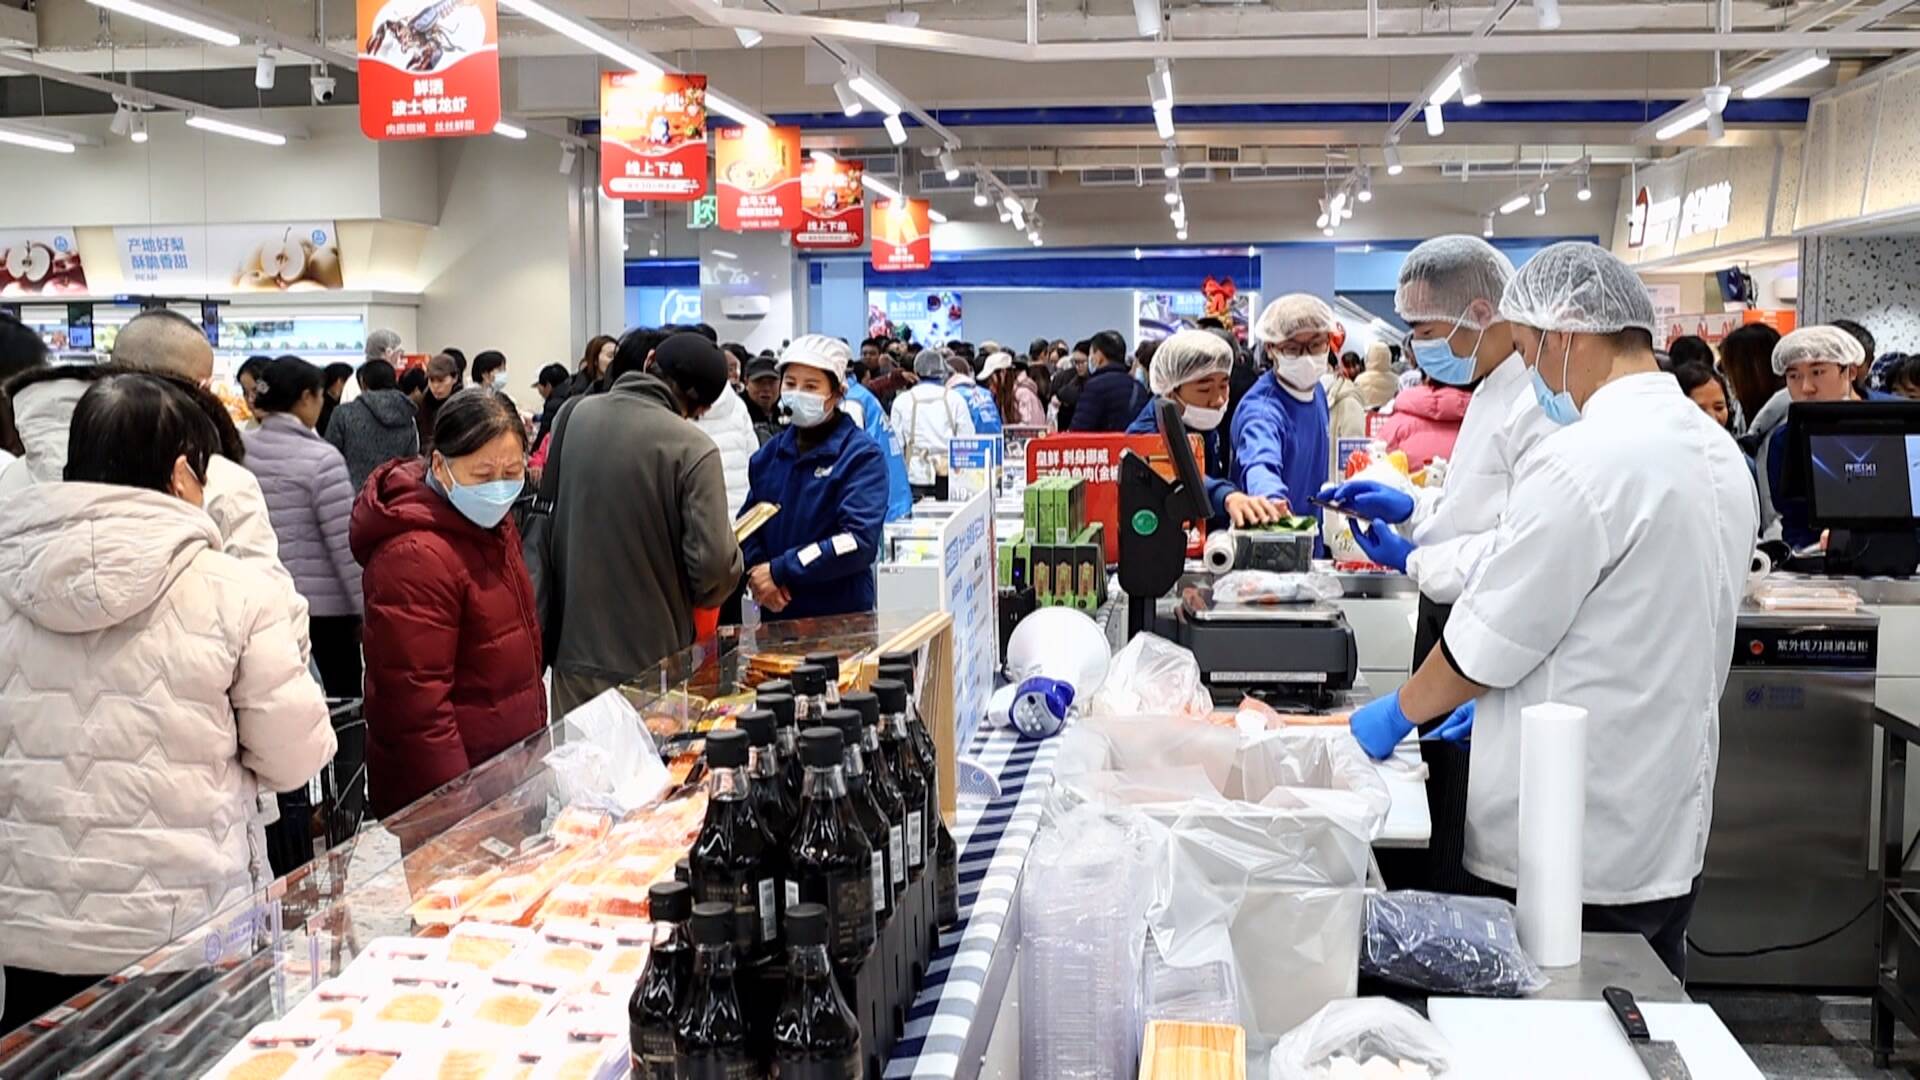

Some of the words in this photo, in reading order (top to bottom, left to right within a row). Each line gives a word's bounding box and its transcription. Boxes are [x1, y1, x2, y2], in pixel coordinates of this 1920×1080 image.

[392, 97, 467, 116] 波士顿龙虾
[625, 159, 684, 177] 线上下单
[807, 219, 848, 232] 线上下单
[128, 236, 184, 252] 产地好梨
[1777, 639, 1869, 652] 紫外线刀具消毒柜
